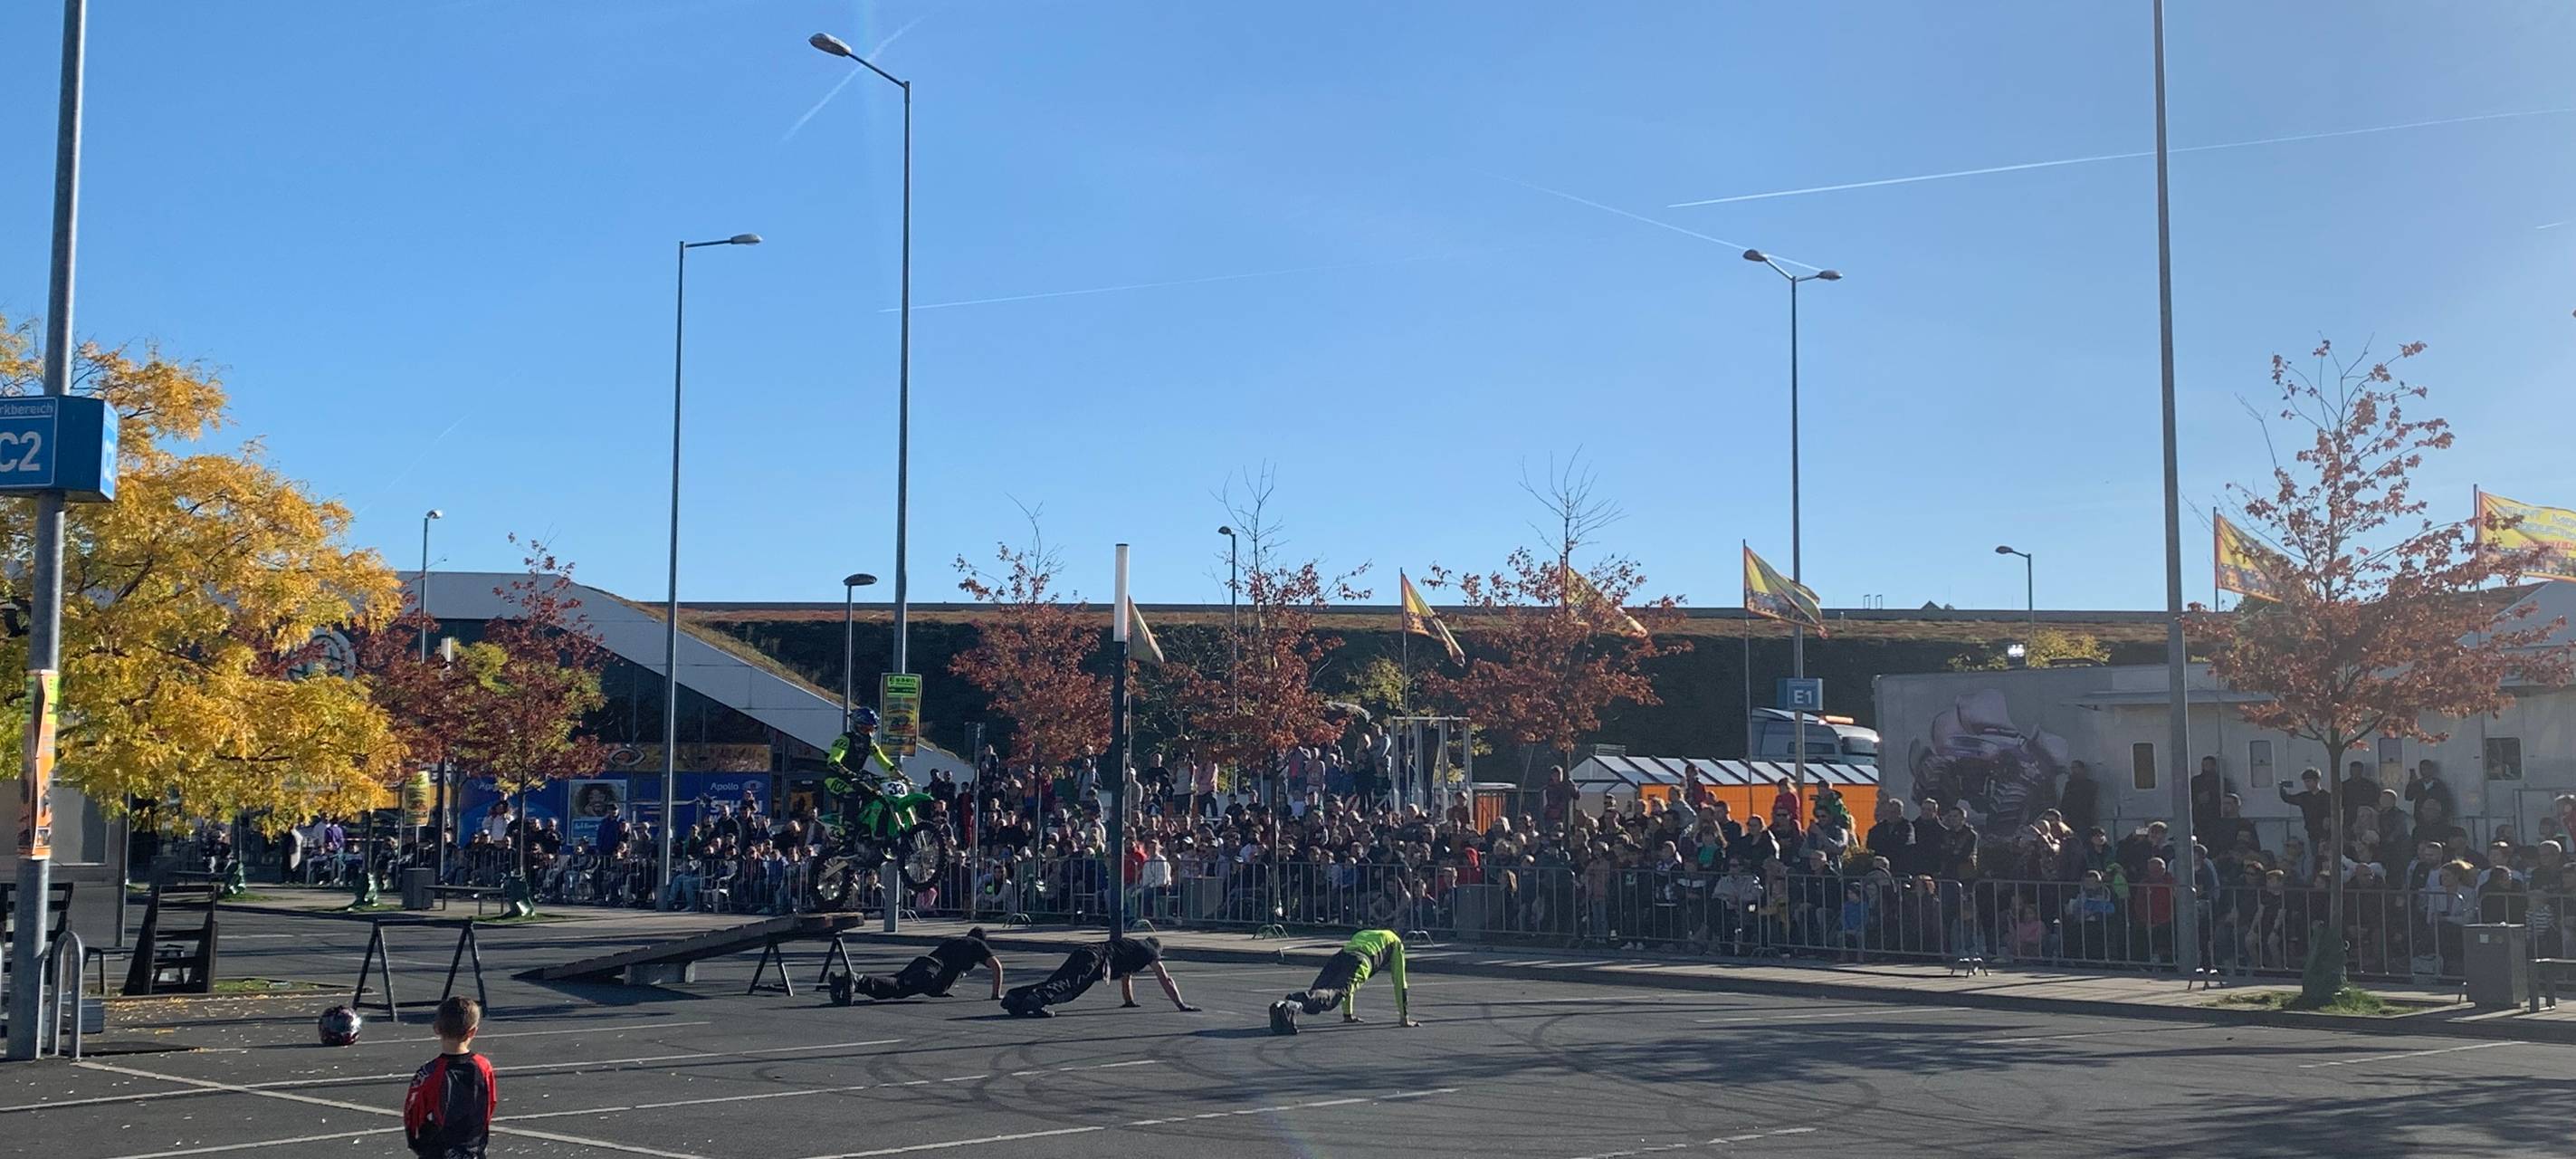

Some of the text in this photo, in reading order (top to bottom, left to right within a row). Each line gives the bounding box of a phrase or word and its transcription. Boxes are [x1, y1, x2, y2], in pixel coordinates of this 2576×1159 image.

[0, 431, 42, 472] C2
[1794, 690, 1812, 704] E1
[711, 782, 739, 791] Apollo
[888, 783, 905, 795] 33
